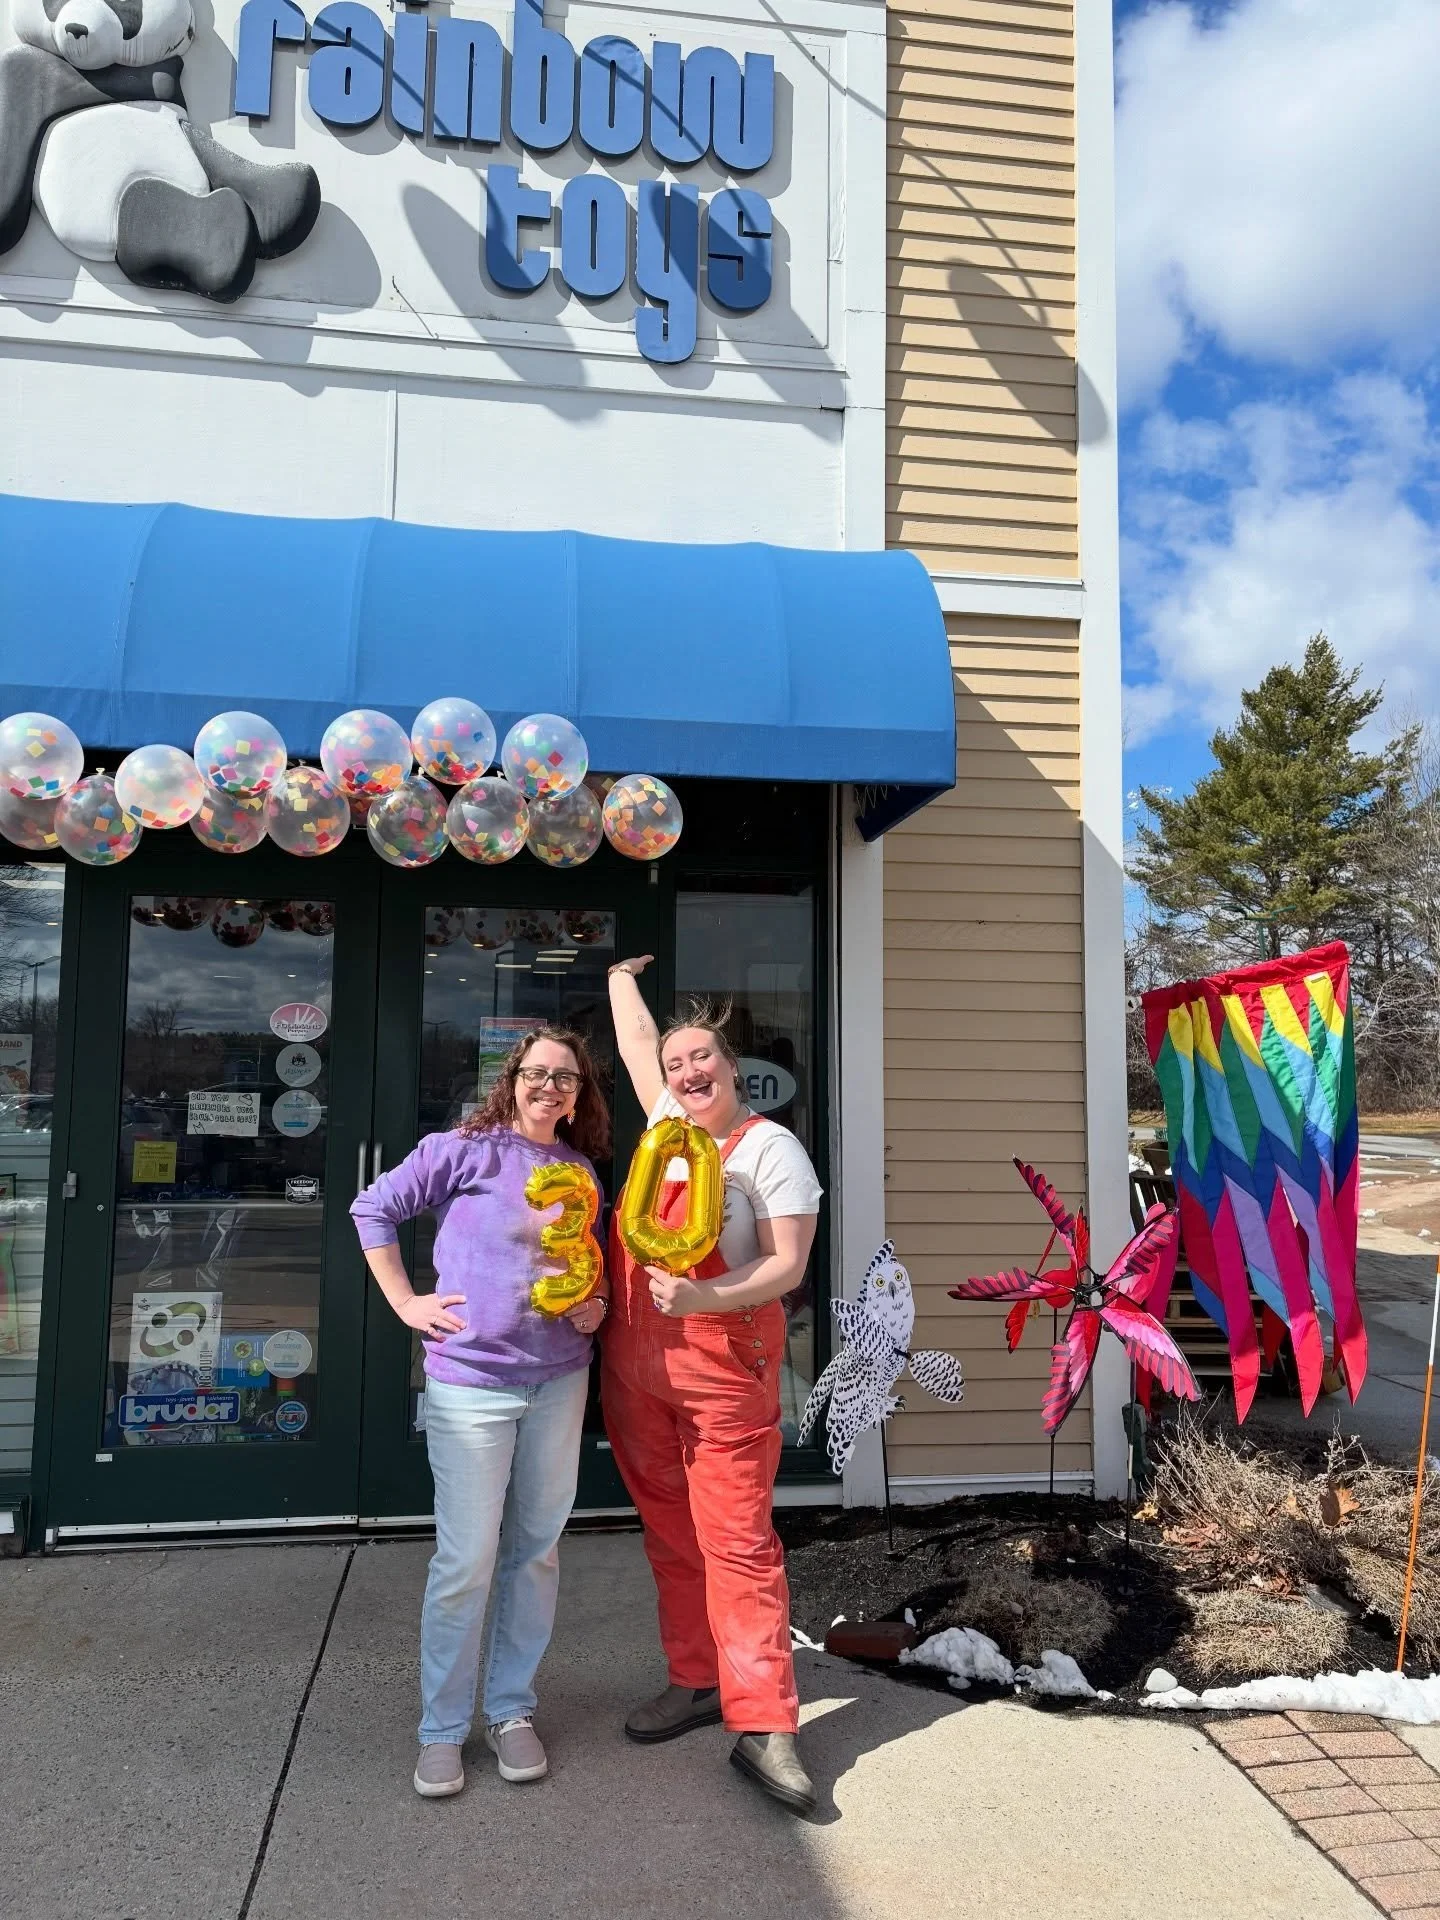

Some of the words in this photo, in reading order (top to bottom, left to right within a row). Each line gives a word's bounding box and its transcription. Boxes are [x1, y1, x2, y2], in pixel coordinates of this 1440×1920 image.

[234, 0, 775, 171] rainbow
[486, 163, 773, 365] toys
[746, 1074, 779, 1100] EN
[125, 1395, 234, 1423] bruder
